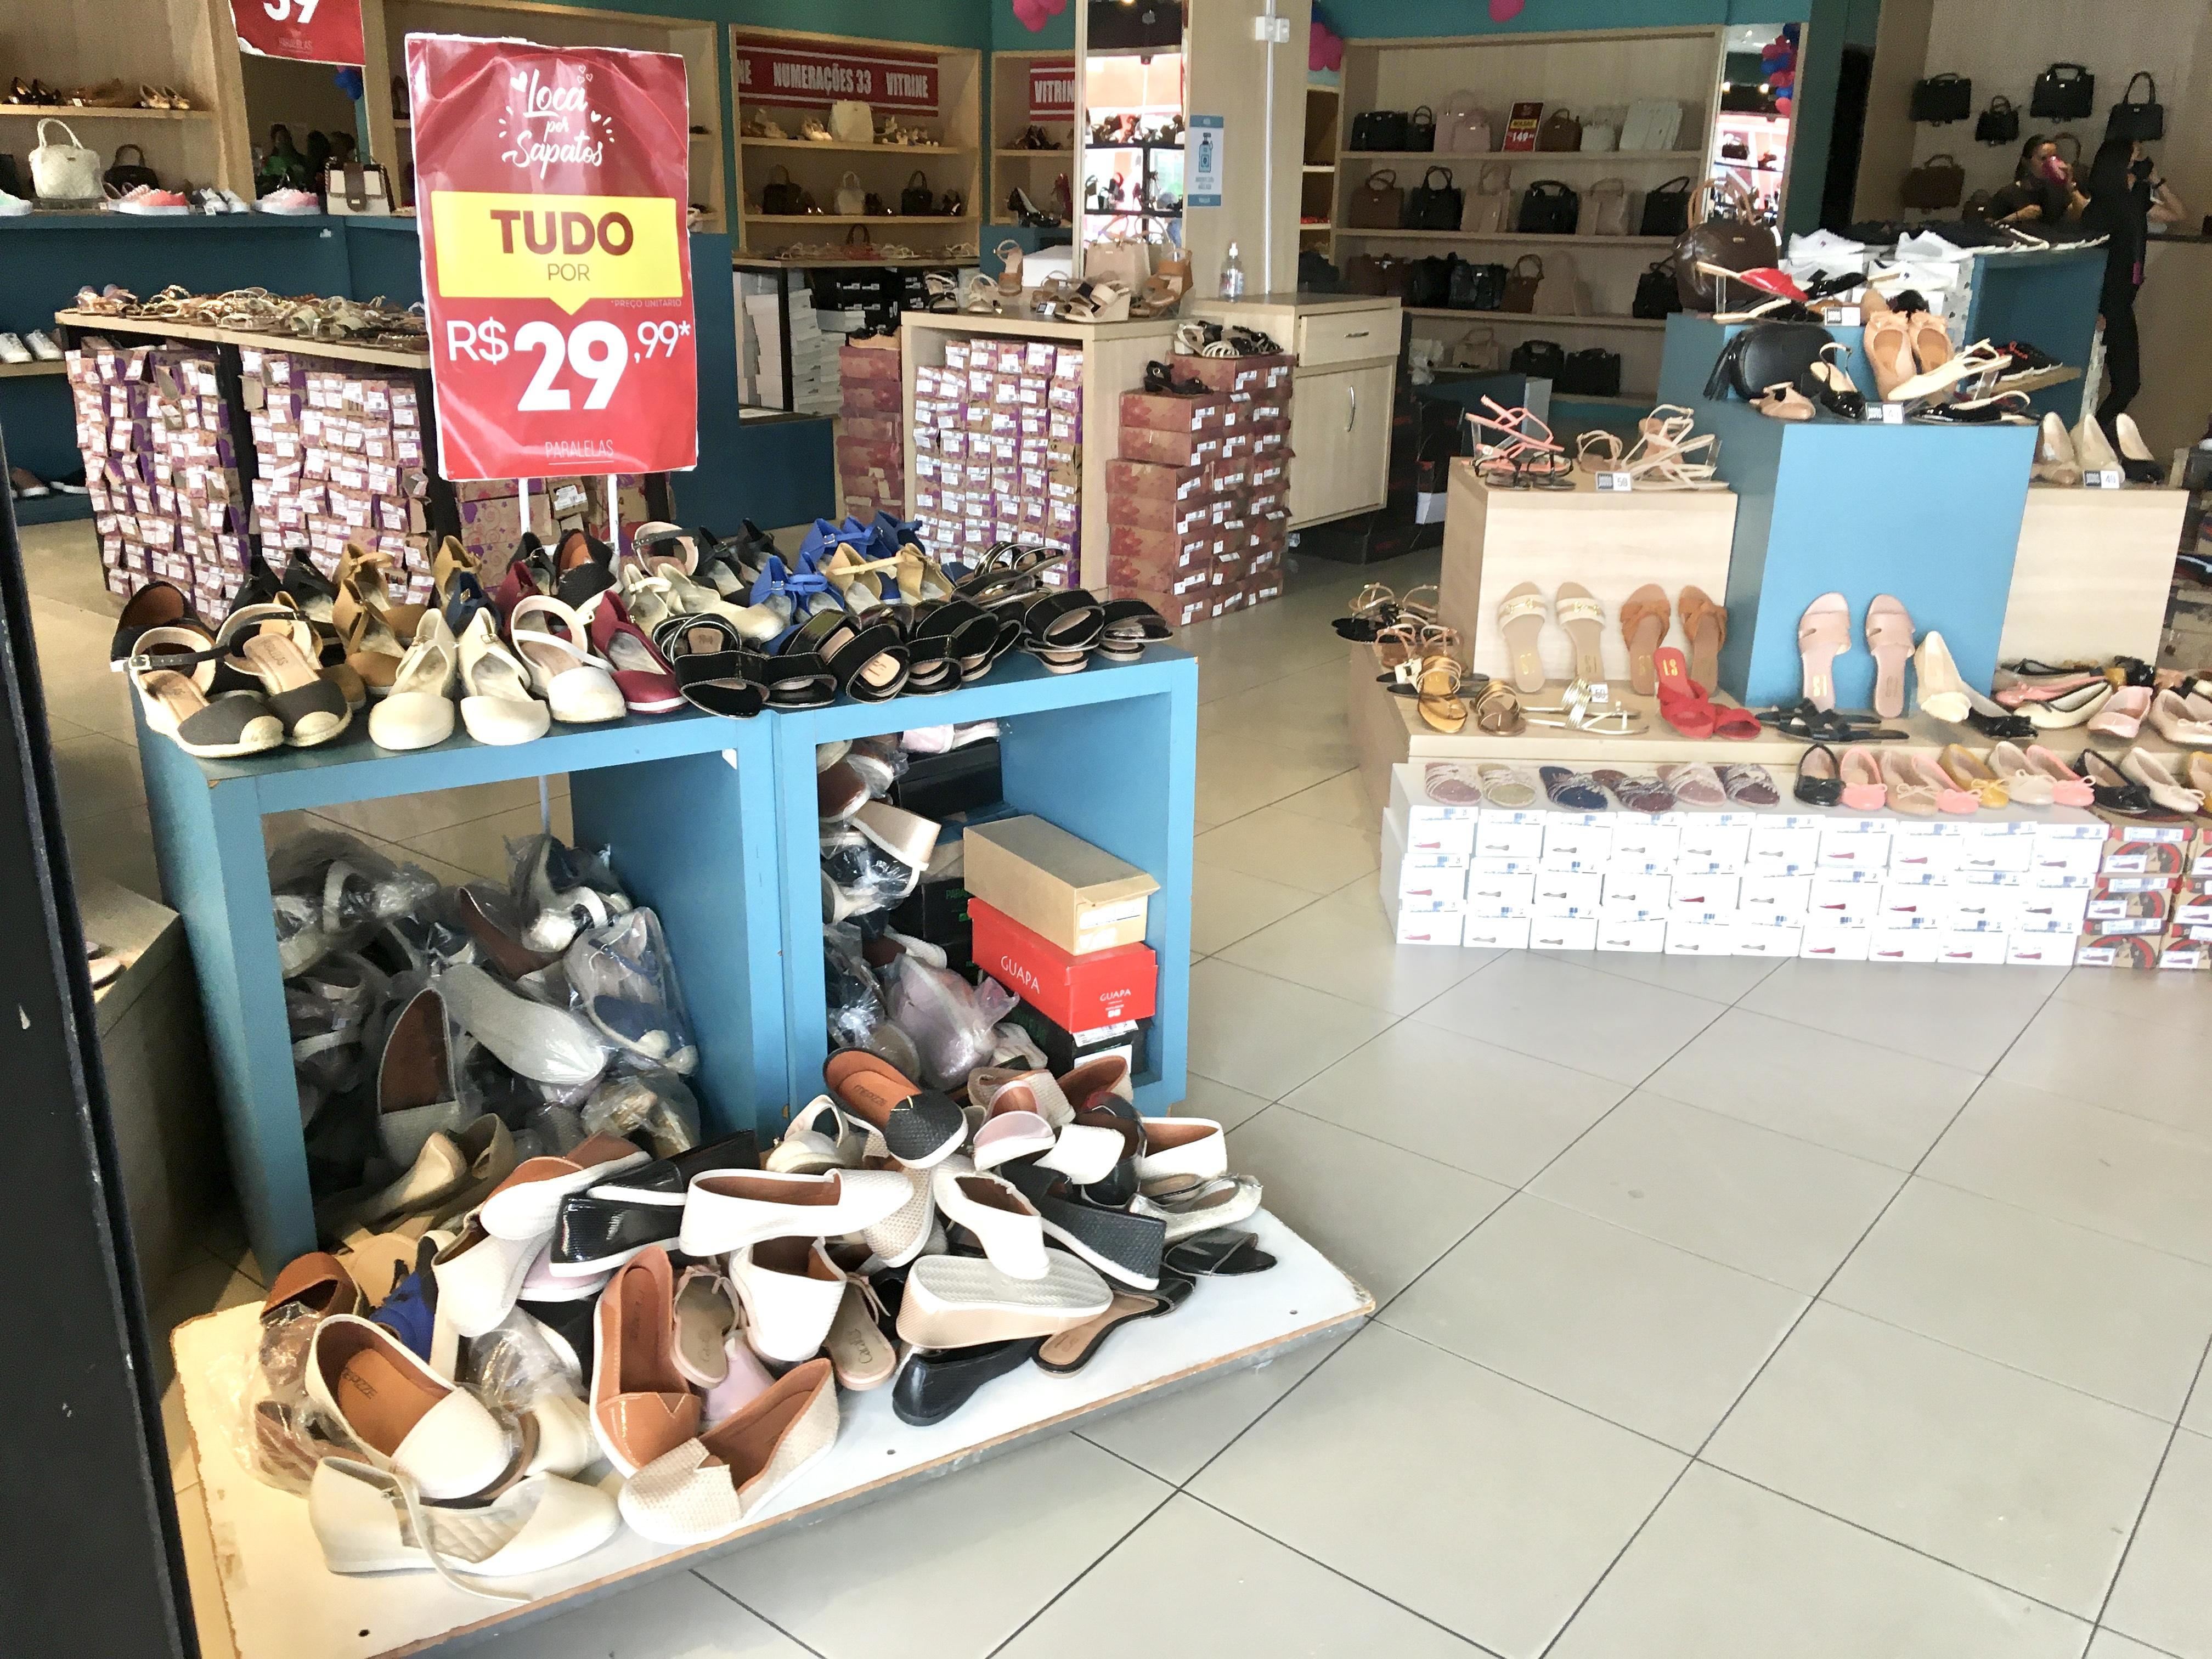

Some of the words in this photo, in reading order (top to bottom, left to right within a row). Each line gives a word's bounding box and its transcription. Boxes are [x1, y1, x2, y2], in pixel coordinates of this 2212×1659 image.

[523, 69, 589, 118] Loca
[773, 62, 854, 96] NUMERAÇÕES
[856, 70, 872, 94] 33
[885, 72, 928, 98] VITRINE
[544, 116, 569, 142] por
[501, 129, 603, 179] Sapatos
[490, 210, 634, 256] TUDO
[548, 263, 591, 281] POR
[447, 317, 509, 365] R$
[545, 439, 614, 459] PARALELAS
[1001, 955, 1040, 995] GUAPA
[1099, 989, 1131, 1001] GUAPA
